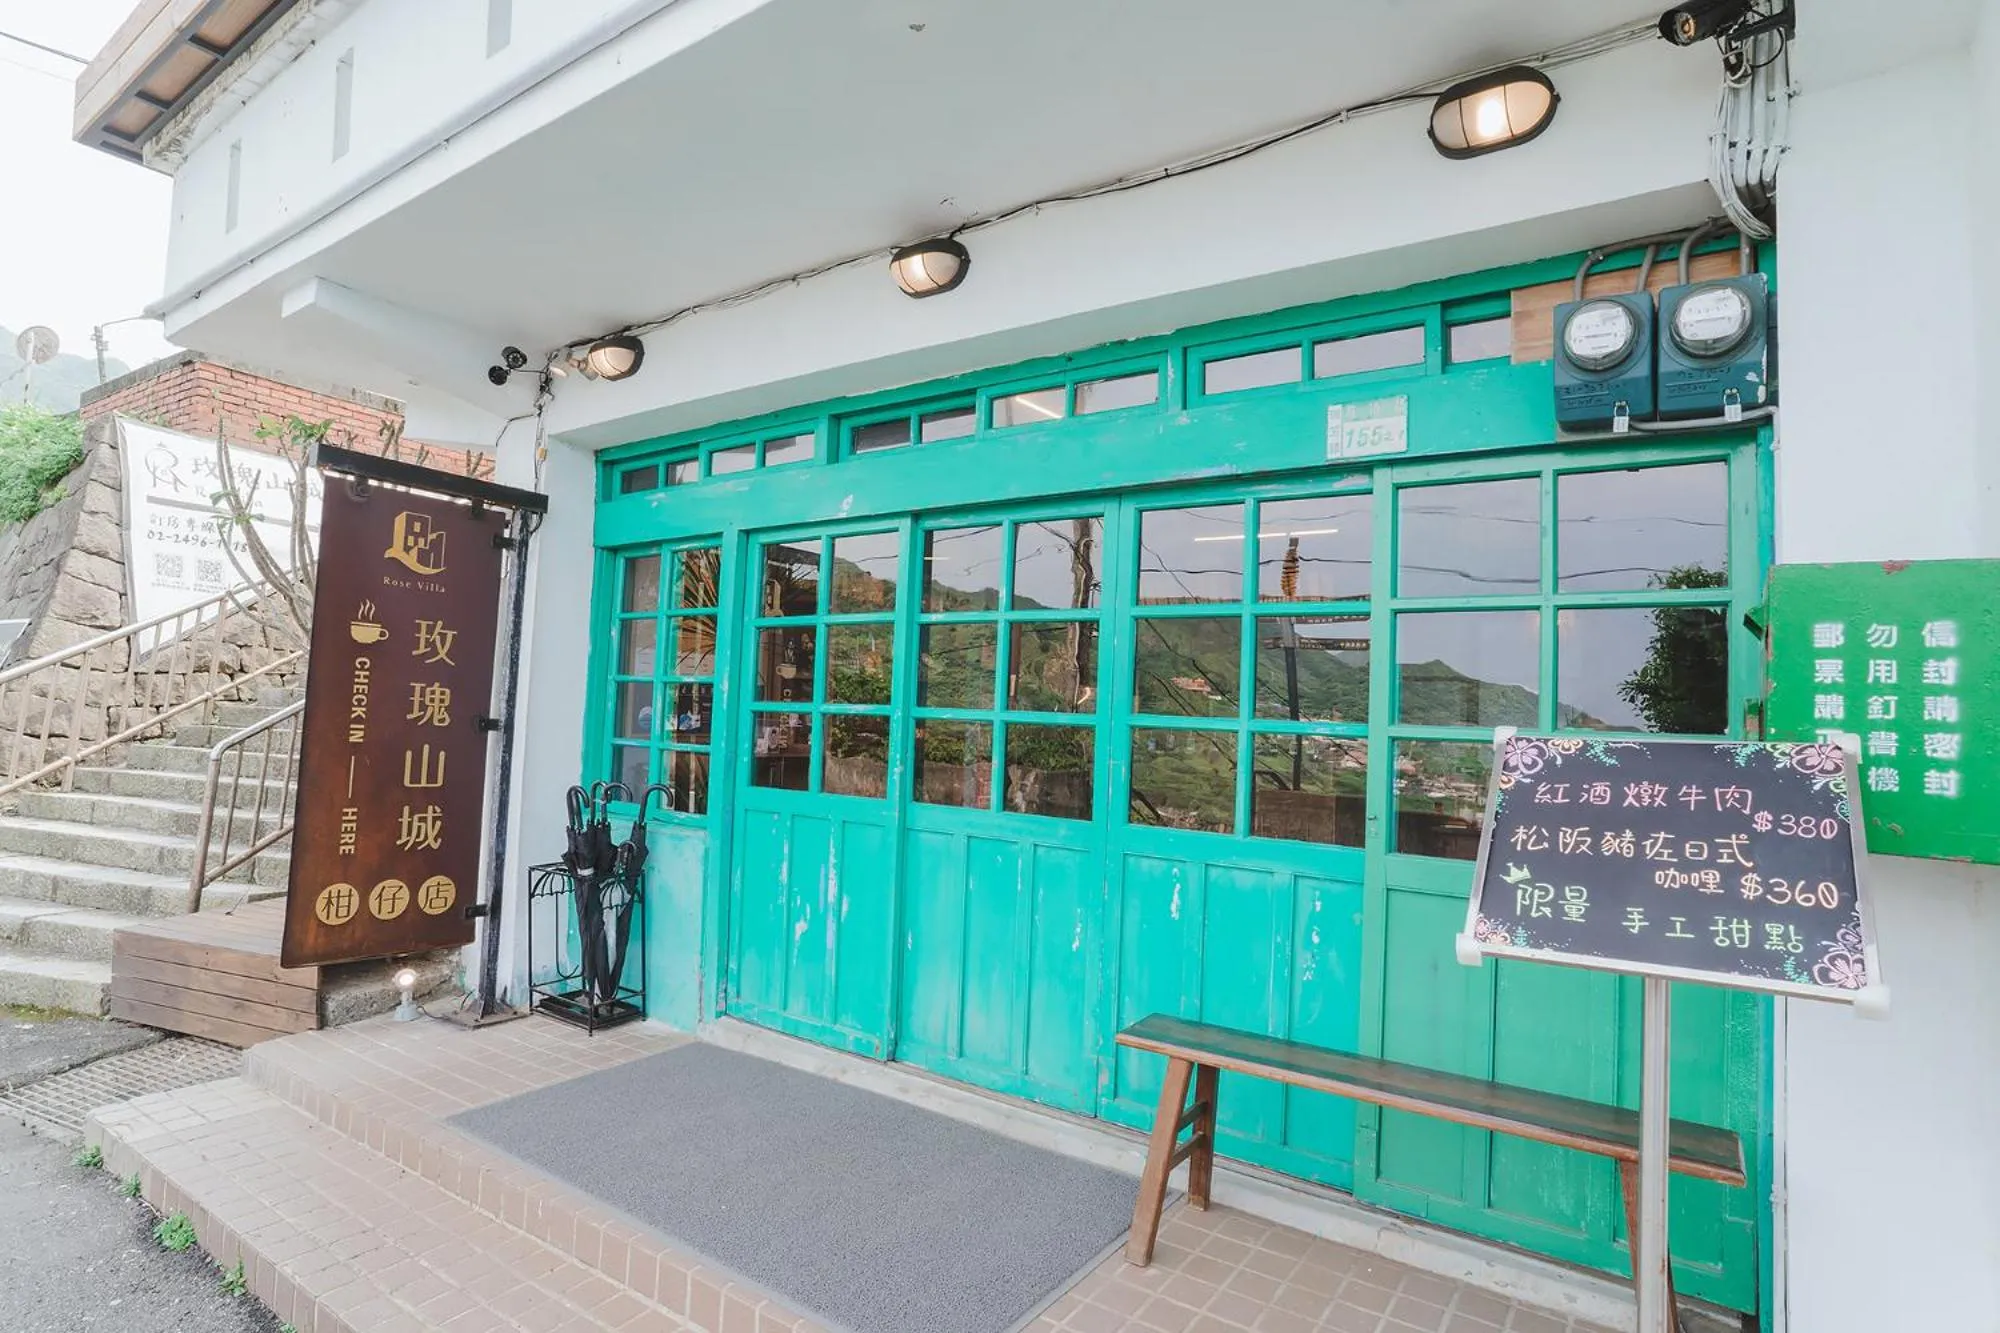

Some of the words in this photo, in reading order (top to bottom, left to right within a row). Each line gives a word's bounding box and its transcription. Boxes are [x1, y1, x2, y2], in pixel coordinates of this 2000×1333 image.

[147, 529, 248, 553] 02-2496-778
[383, 576, 411, 589] Rose
[417, 581, 445, 593] Villa
[351, 657, 370, 719] CHECK
[1866, 623, 1900, 793] 勿用釘書機
[1921, 621, 1961, 798] 信封請密封
[349, 724, 365, 743] IN
[396, 619, 458, 851] 玫瑰山城
[339, 807, 358, 855] HERE
[1534, 781, 1753, 814] 紅酒燉牛肉
[1752, 810, 1839, 840] $380
[1511, 825, 1754, 867] 松阪豬佐日式
[321, 880, 453, 921] 柑仔店
[1655, 867, 1725, 894] 咖哩
[1740, 872, 1839, 909] $360
[1516, 883, 1590, 922] 限量
[1621, 907, 1804, 953] 手工甜點
